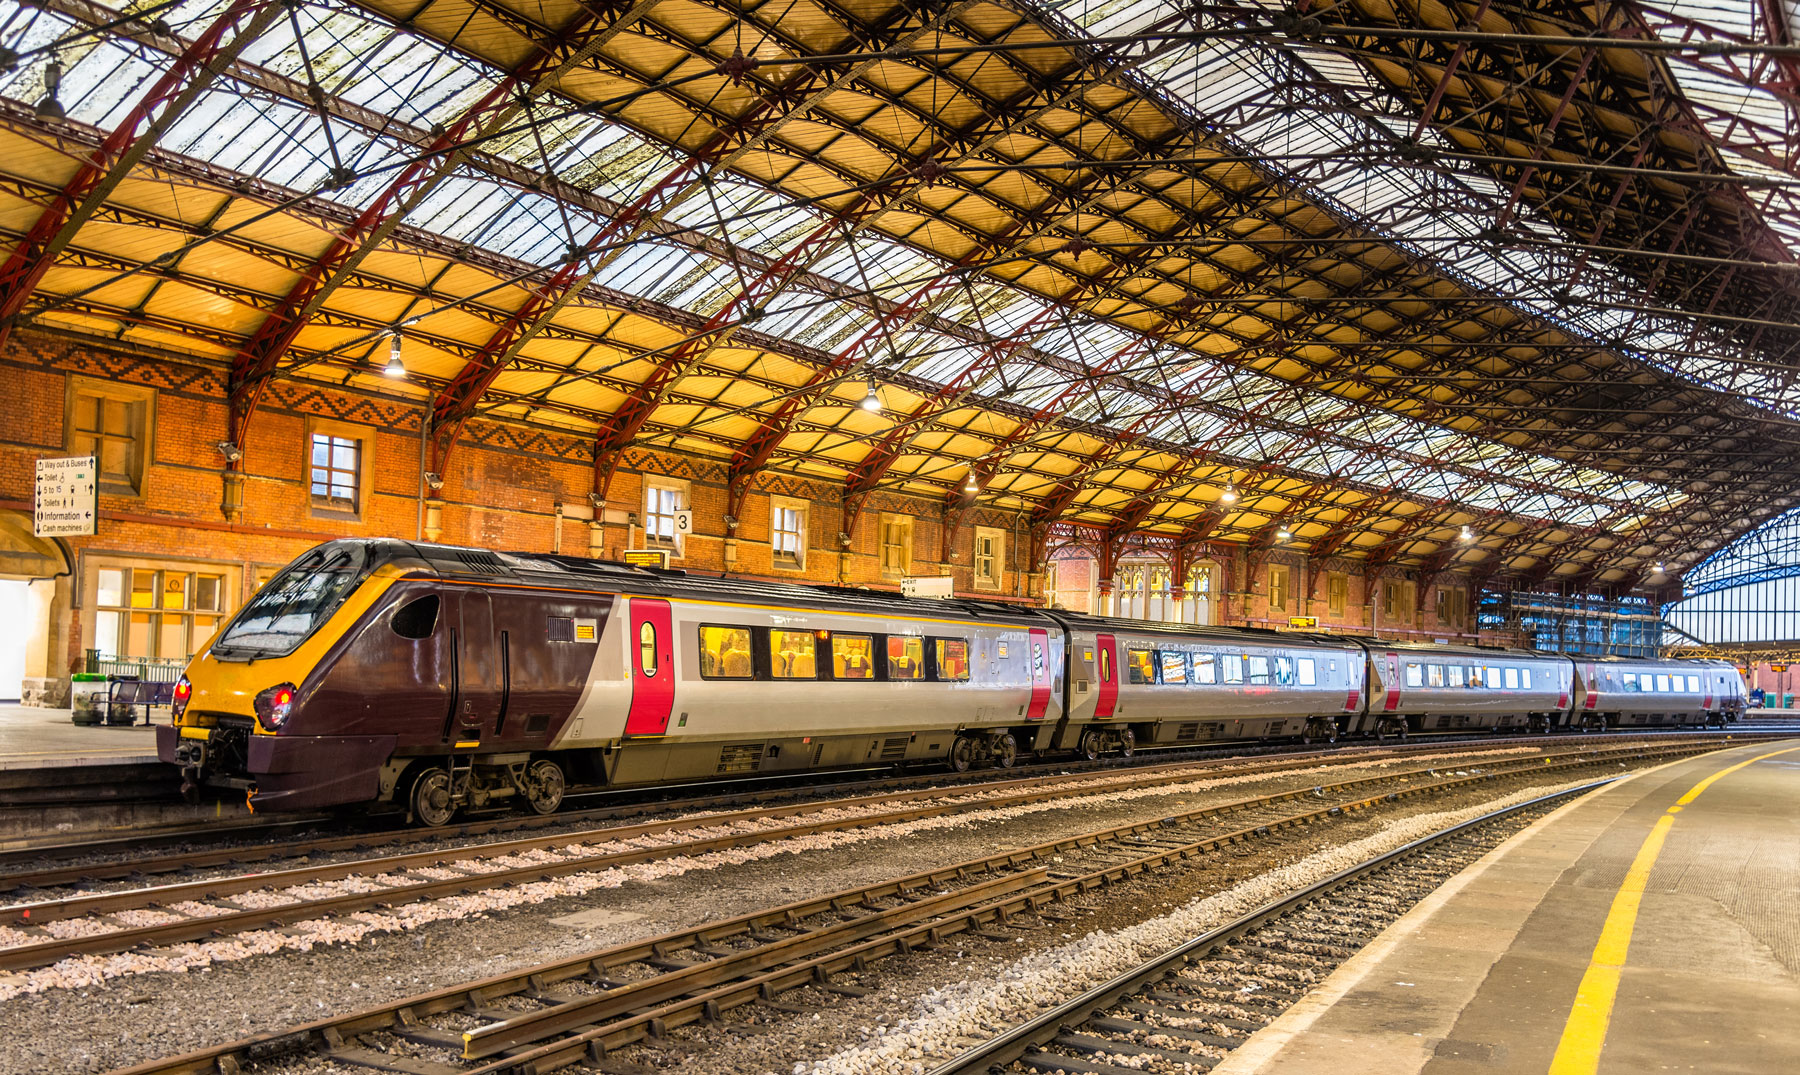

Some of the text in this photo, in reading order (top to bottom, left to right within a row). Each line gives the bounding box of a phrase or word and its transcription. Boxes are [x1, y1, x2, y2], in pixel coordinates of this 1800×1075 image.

[45, 461, 55, 469] Way
[44, 486, 47, 494] 5
[56, 485, 61, 493] 15
[44, 499, 60, 507] Toilets
[45, 512, 80, 520] Information
[678, 514, 687, 530] 3
[43, 524, 82, 532] Cash machines
